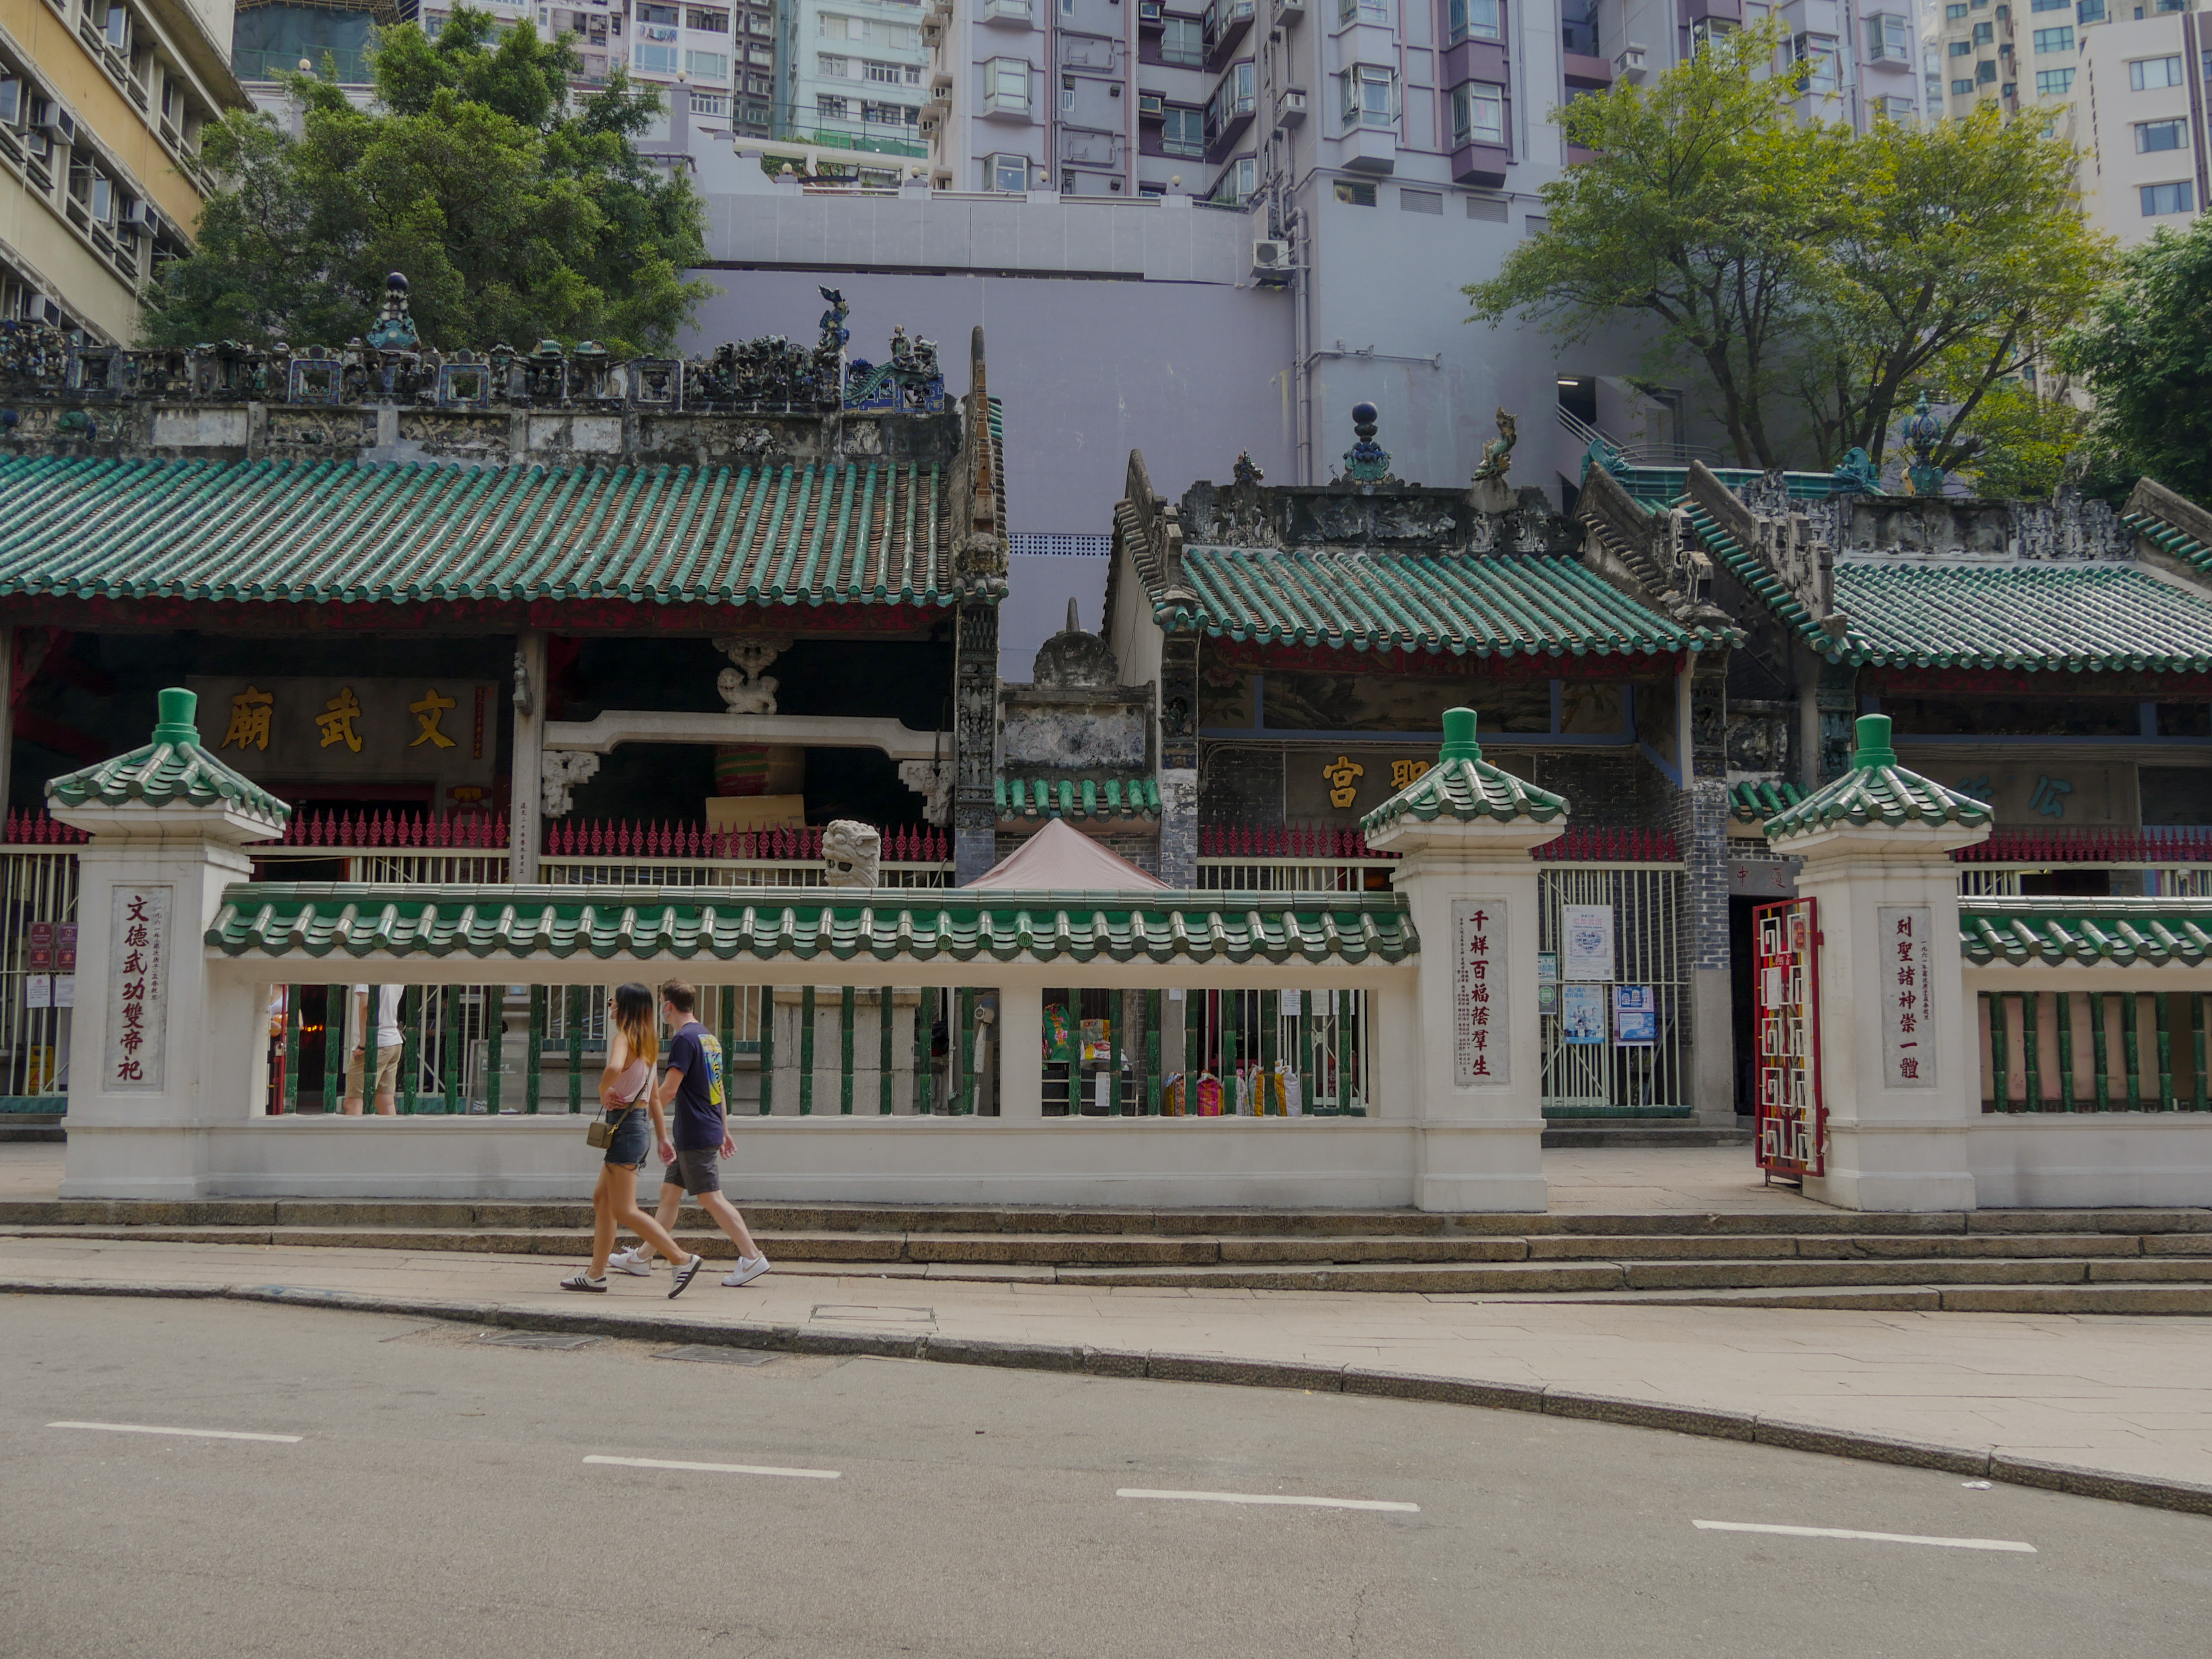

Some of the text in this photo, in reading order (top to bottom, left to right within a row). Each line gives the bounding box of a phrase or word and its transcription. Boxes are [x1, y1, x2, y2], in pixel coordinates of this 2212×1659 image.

[221, 685, 457, 753] 文武廟
[117, 895, 150, 1081] 文德武功雙帝祀
[1896, 916, 1919, 1079] 列聖諸神崇一體
